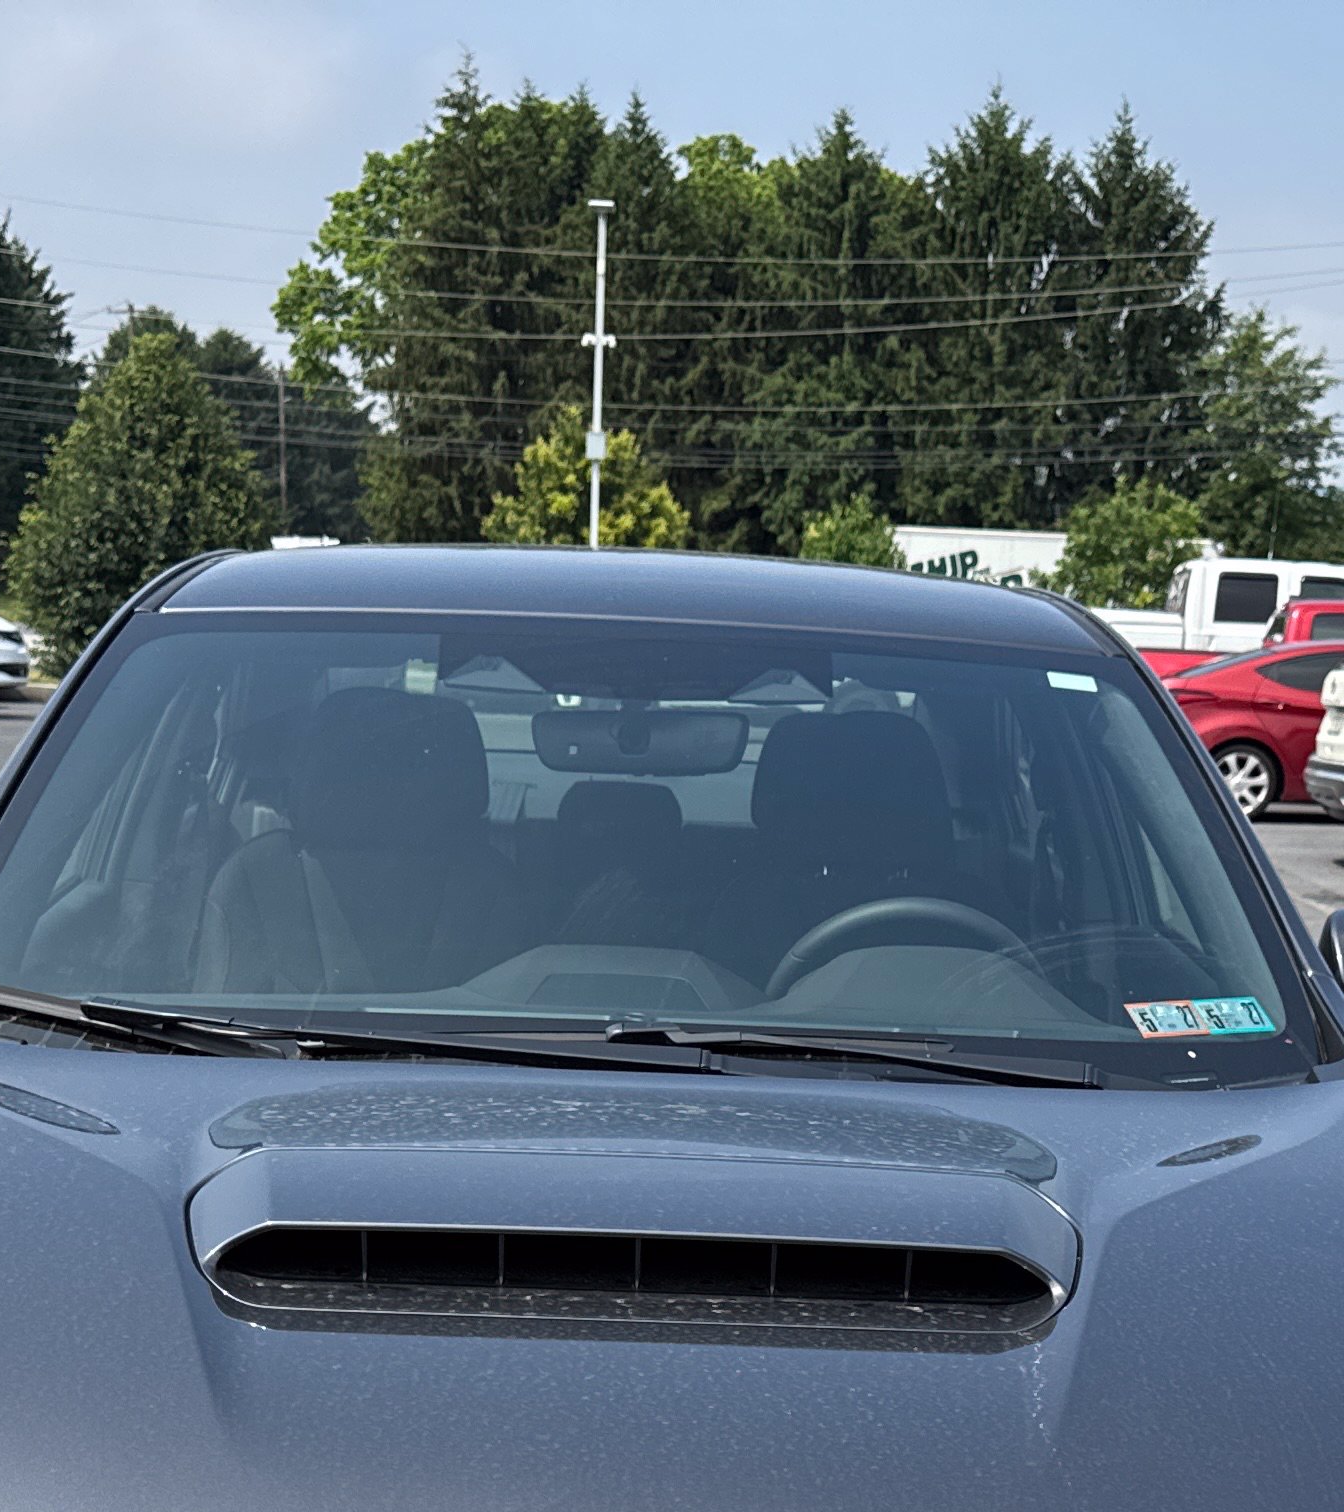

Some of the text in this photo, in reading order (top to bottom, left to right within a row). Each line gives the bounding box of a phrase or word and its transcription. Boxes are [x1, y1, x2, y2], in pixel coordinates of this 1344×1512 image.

[1139, 1005, 1201, 1033] 5 27
[1206, 1001, 1265, 1030] 5 27
